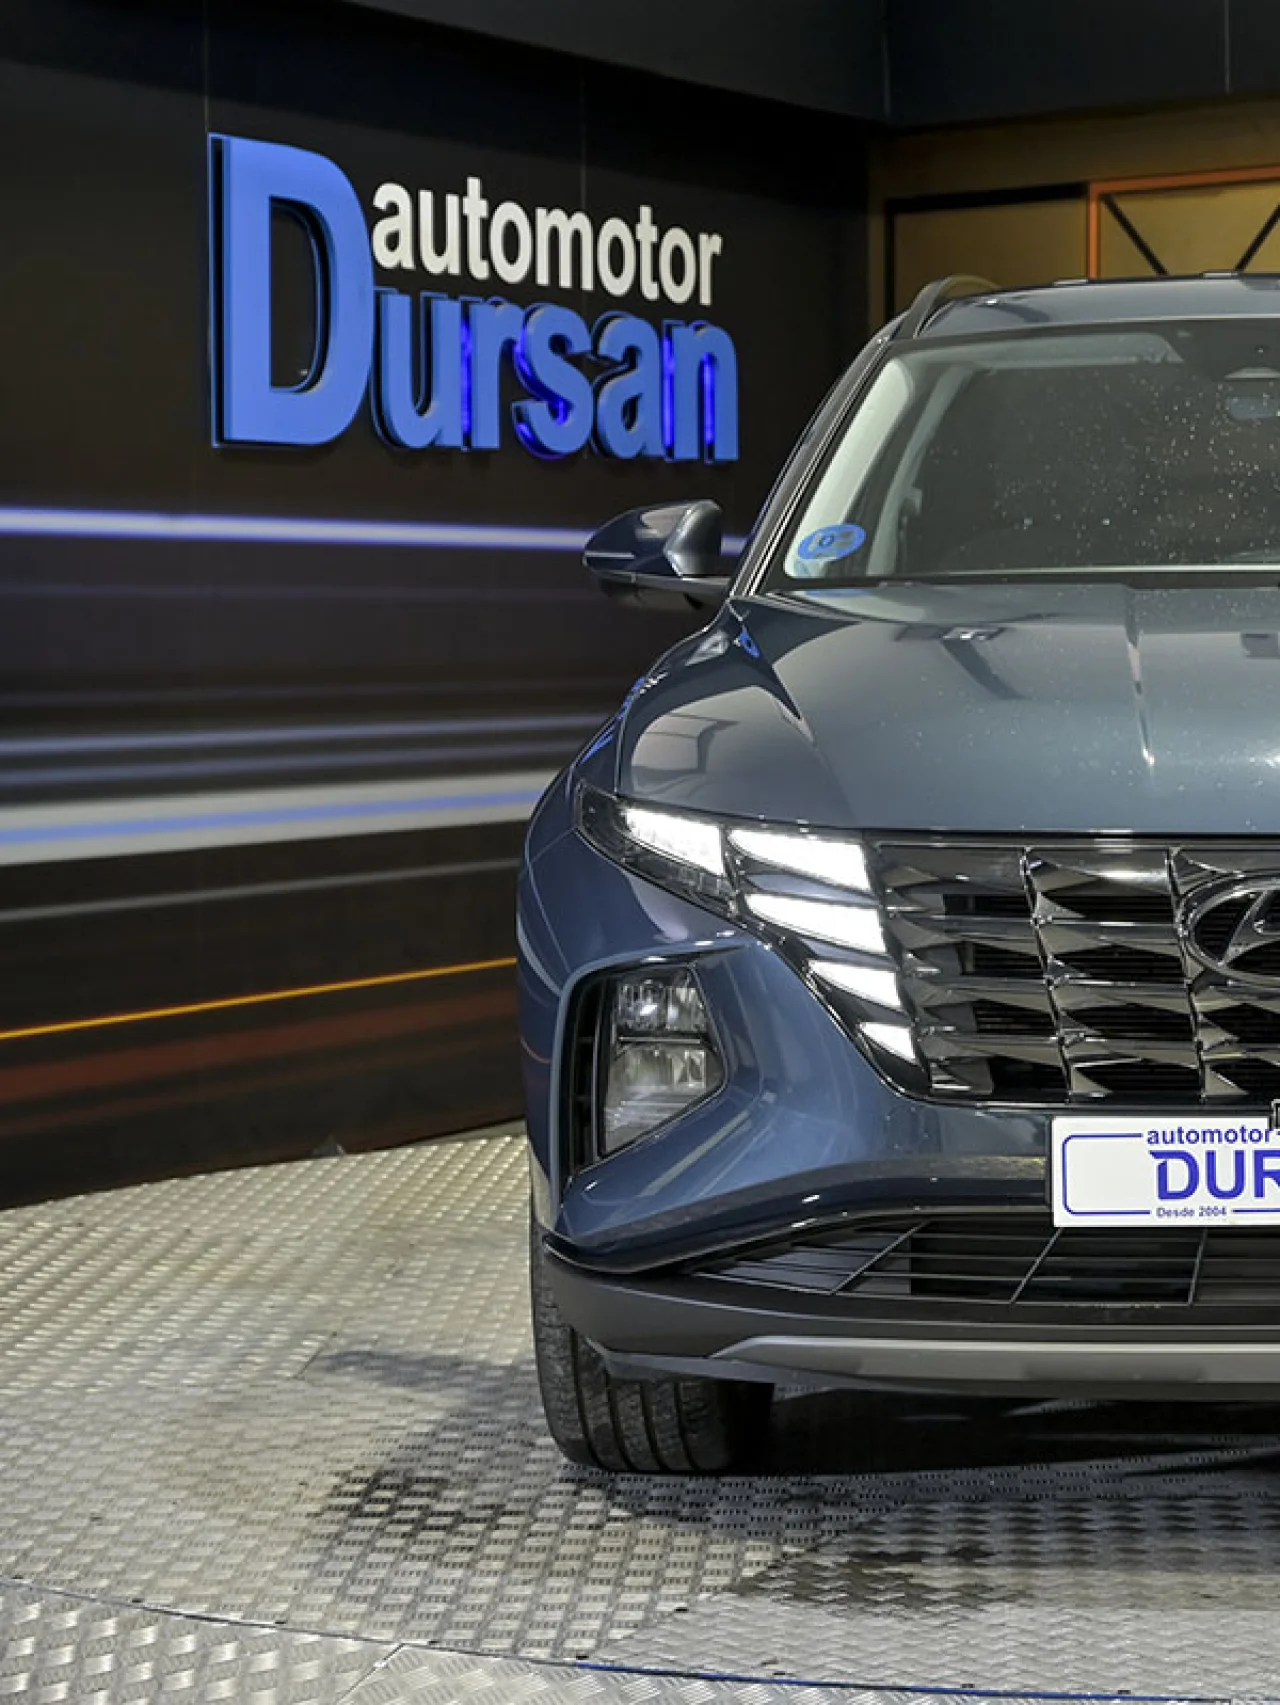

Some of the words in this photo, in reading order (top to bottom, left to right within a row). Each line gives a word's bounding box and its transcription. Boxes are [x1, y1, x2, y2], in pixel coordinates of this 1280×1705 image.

[372, 176, 722, 305] automotor
[208, 133, 739, 463] Dursan
[1147, 1125, 1272, 1144] automotor
[1156, 1206, 1195, 1217] Desde
[1198, 1205, 1227, 1217] 2004
